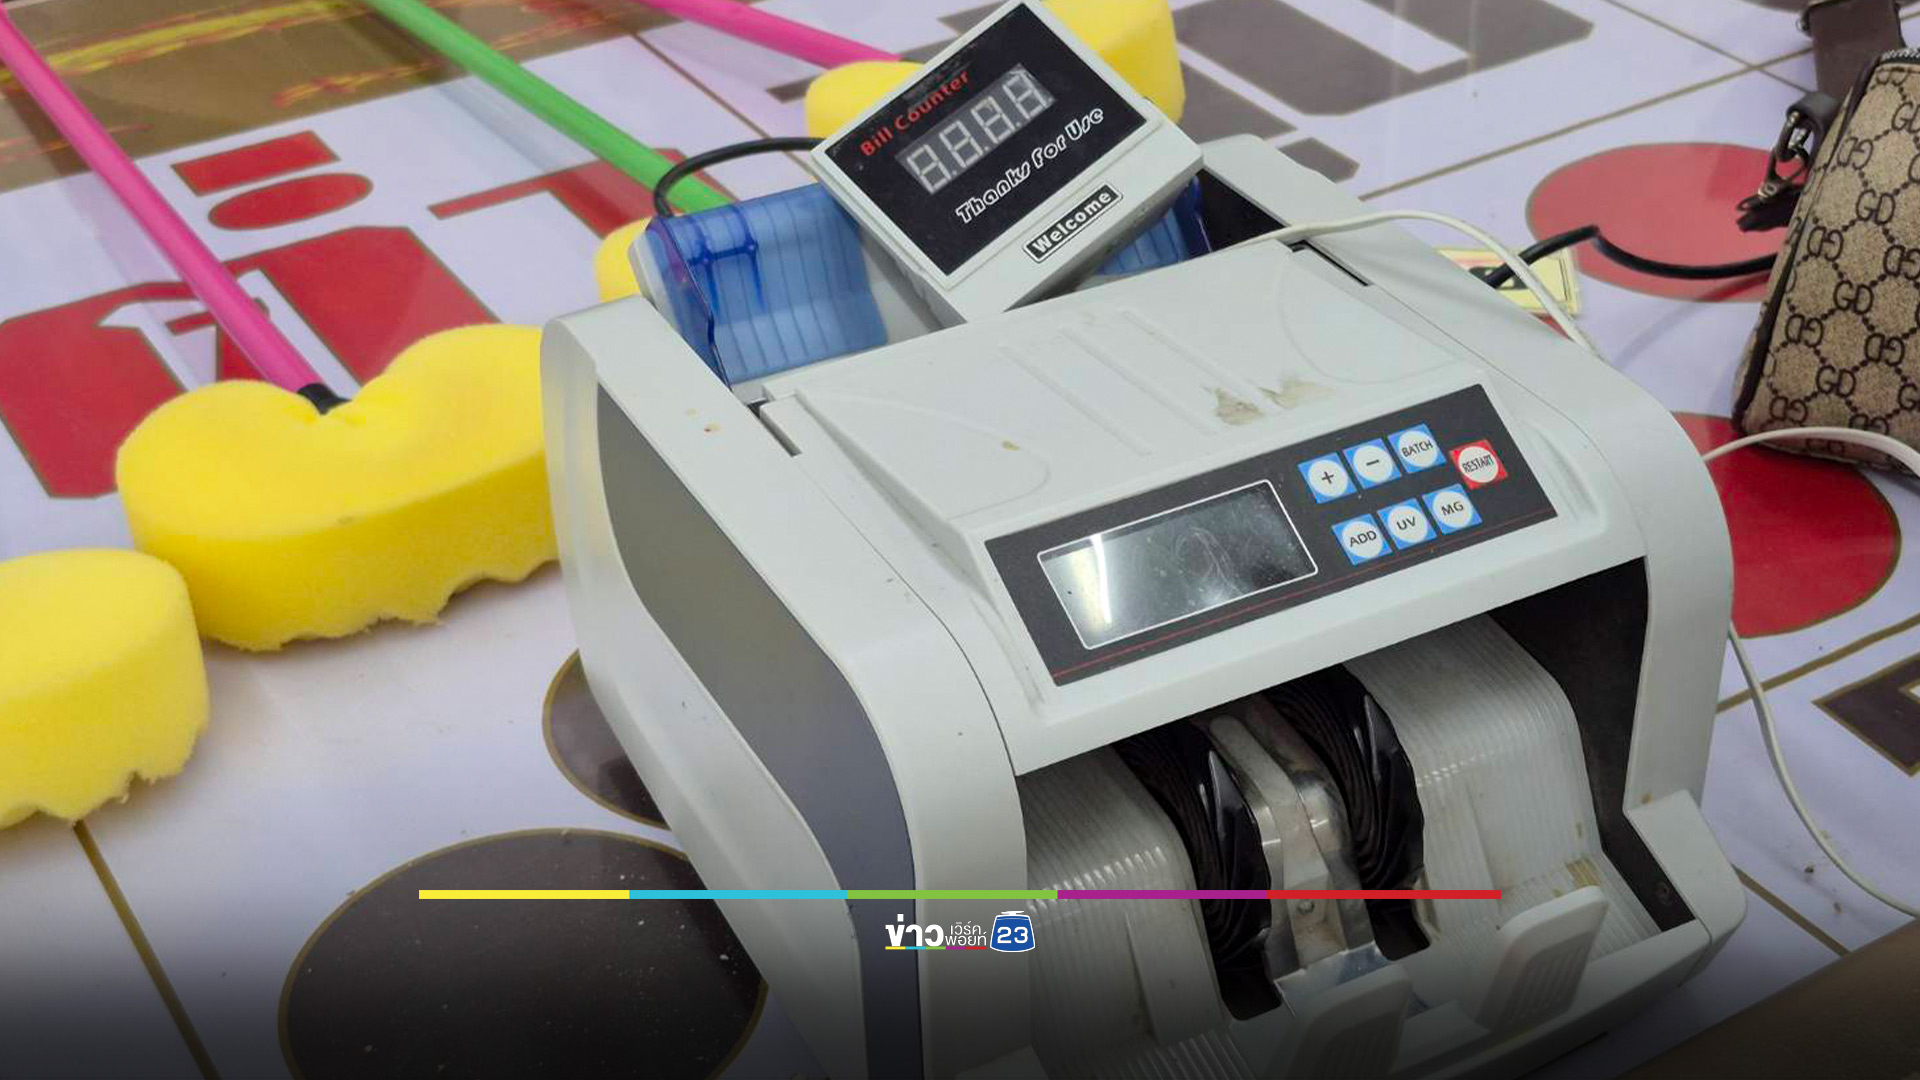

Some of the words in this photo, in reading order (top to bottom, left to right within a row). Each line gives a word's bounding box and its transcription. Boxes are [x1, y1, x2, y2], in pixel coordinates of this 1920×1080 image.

[860, 126, 894, 157] Bill
[894, 70, 970, 131] Counter
[955, 161, 1031, 223] Thanks
[1064, 107, 1105, 141] Use
[1032, 192, 1112, 253] Welcome
[1401, 440, 1434, 458] BATCH
[1461, 454, 1494, 474] RESTART
[1349, 530, 1377, 548] ADD
[1396, 516, 1417, 531] UV
[1441, 501, 1465, 516] MG
